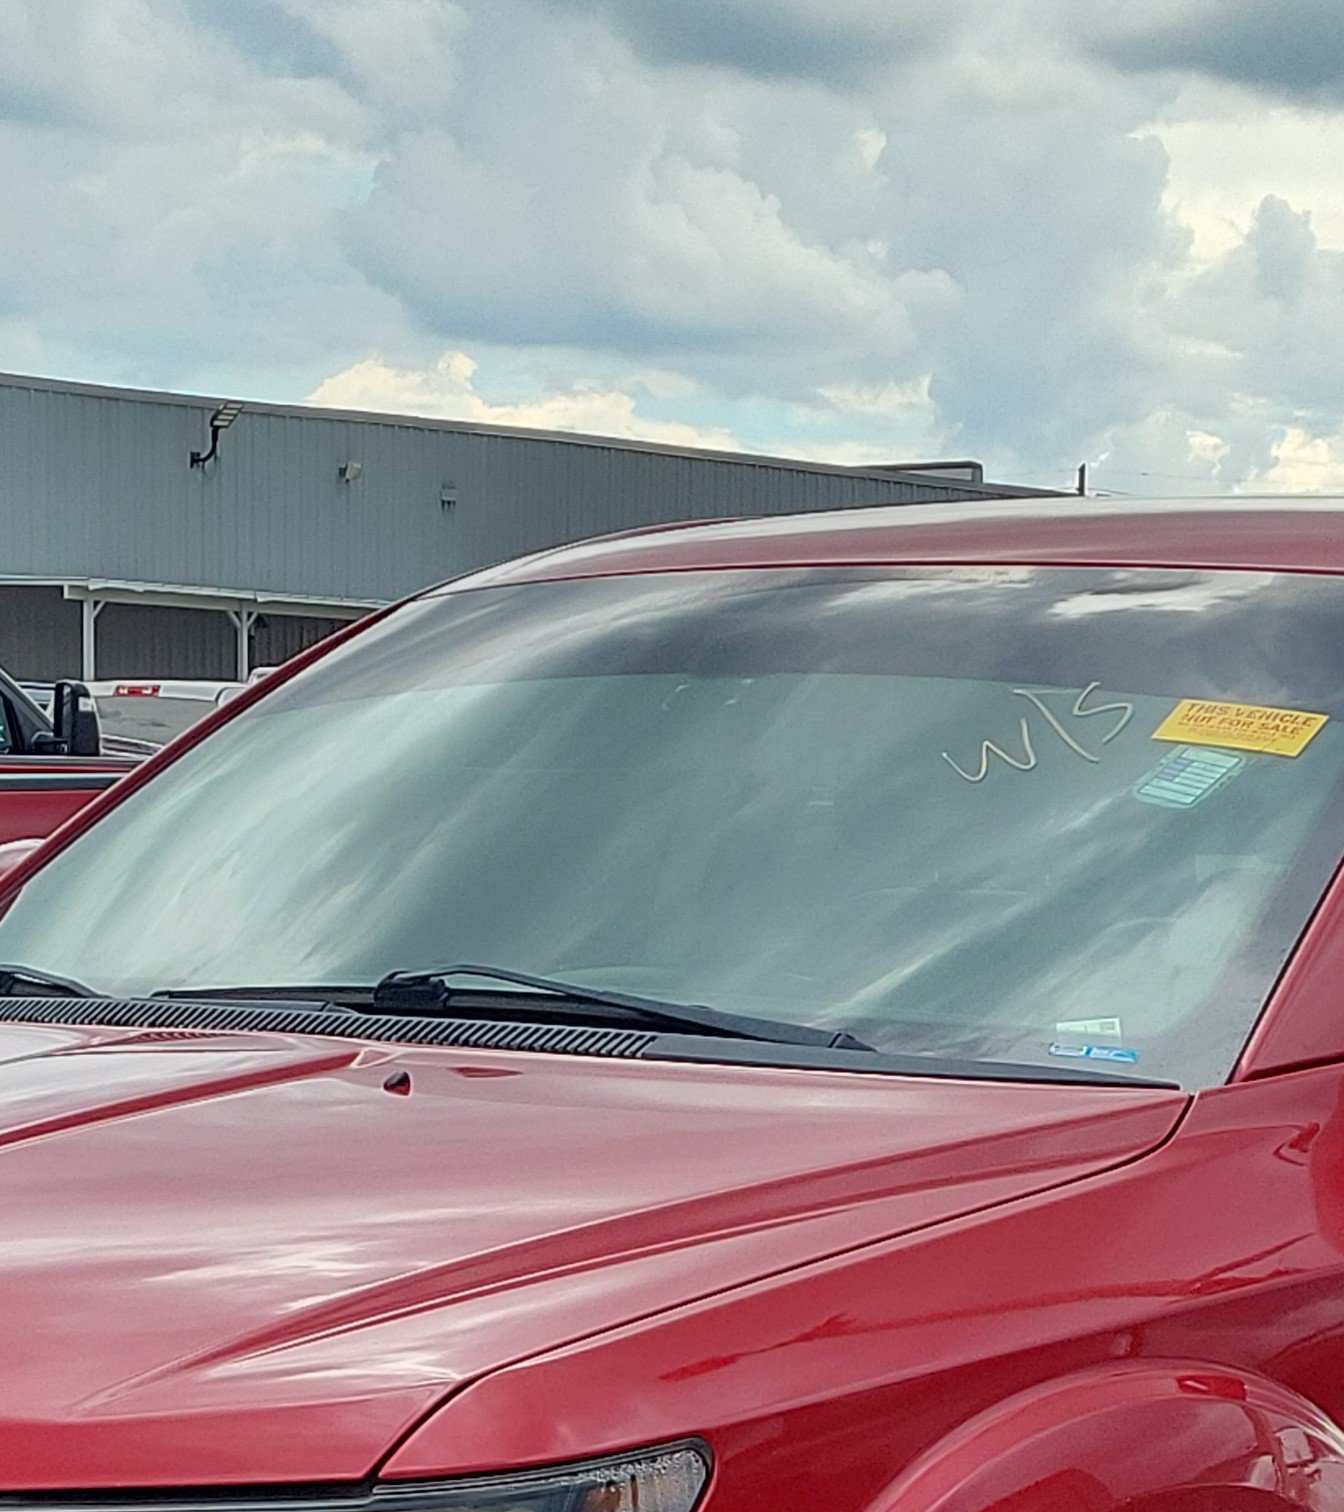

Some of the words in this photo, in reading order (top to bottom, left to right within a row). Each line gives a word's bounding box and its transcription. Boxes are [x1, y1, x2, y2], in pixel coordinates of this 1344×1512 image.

[1186, 702, 1232, 717] THIS
[1236, 707, 1317, 728] VEHICLE
[1218, 717, 1255, 730] FOR
[1257, 722, 1305, 736] SALE
